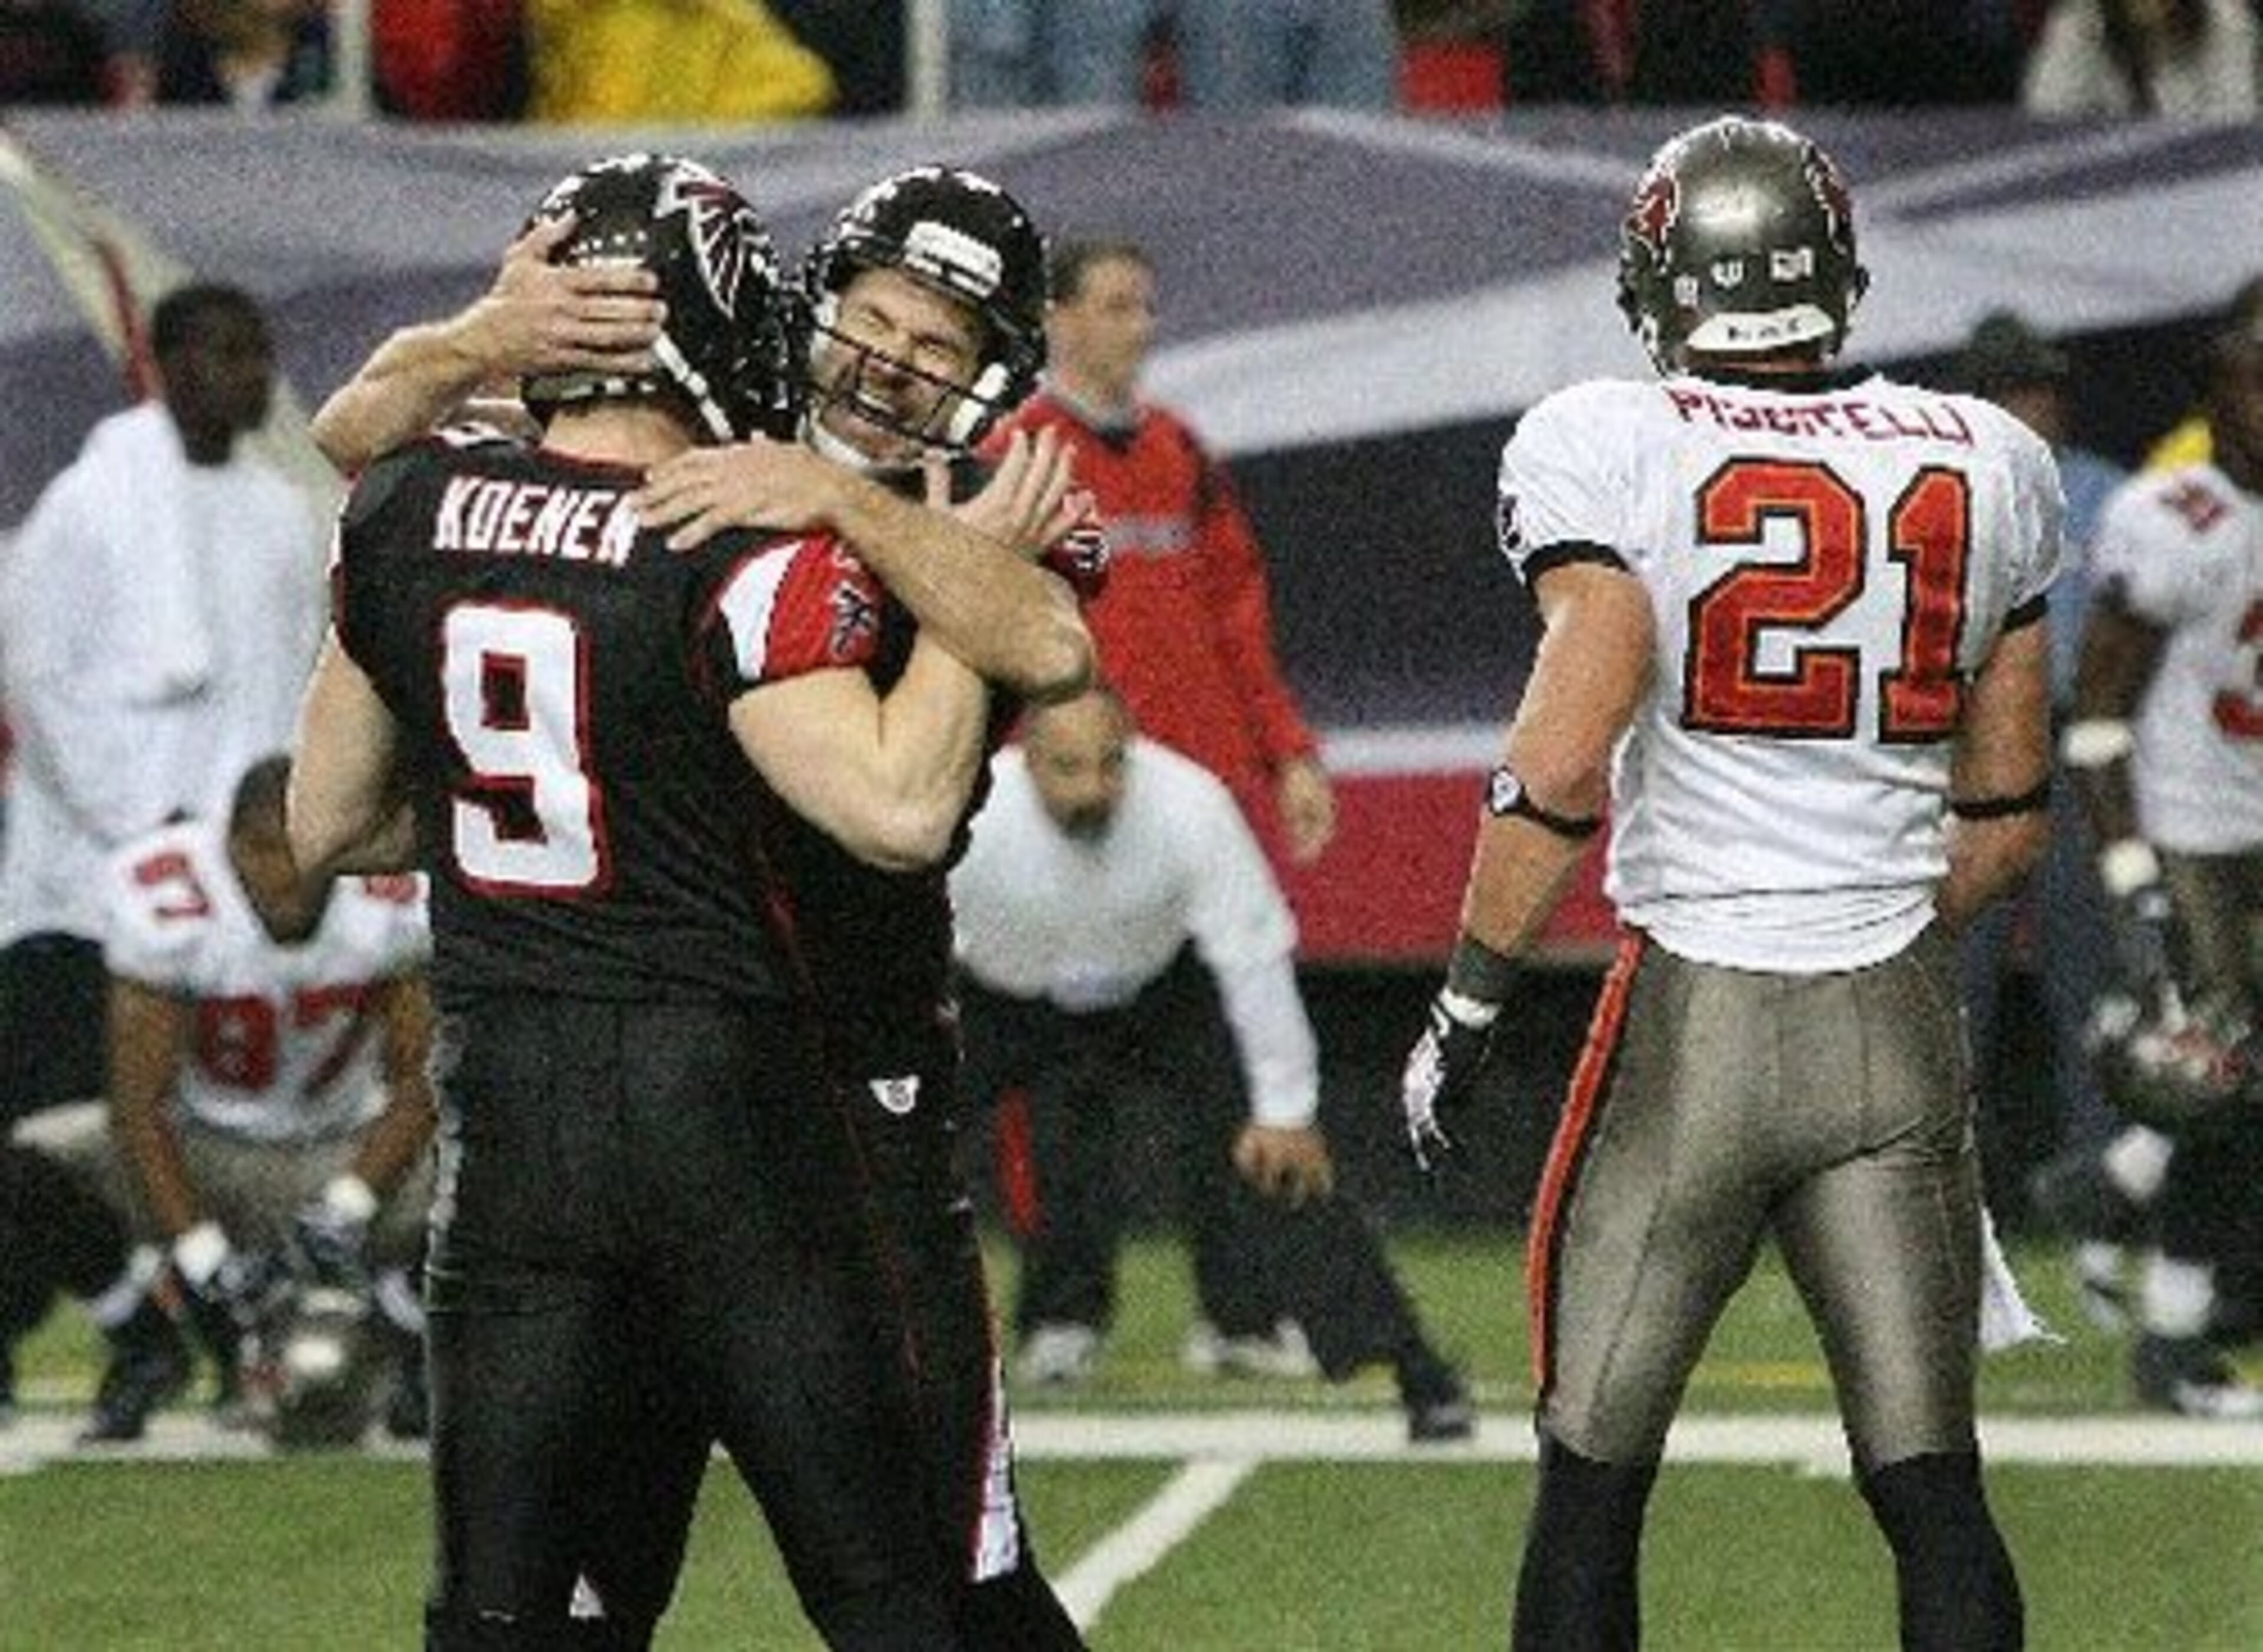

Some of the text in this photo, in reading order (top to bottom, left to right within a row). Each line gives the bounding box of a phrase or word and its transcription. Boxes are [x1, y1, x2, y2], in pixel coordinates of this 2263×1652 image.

[433, 475, 641, 566] KOENEN
[1681, 455, 1972, 744] 21
[442, 599, 612, 897] 9
